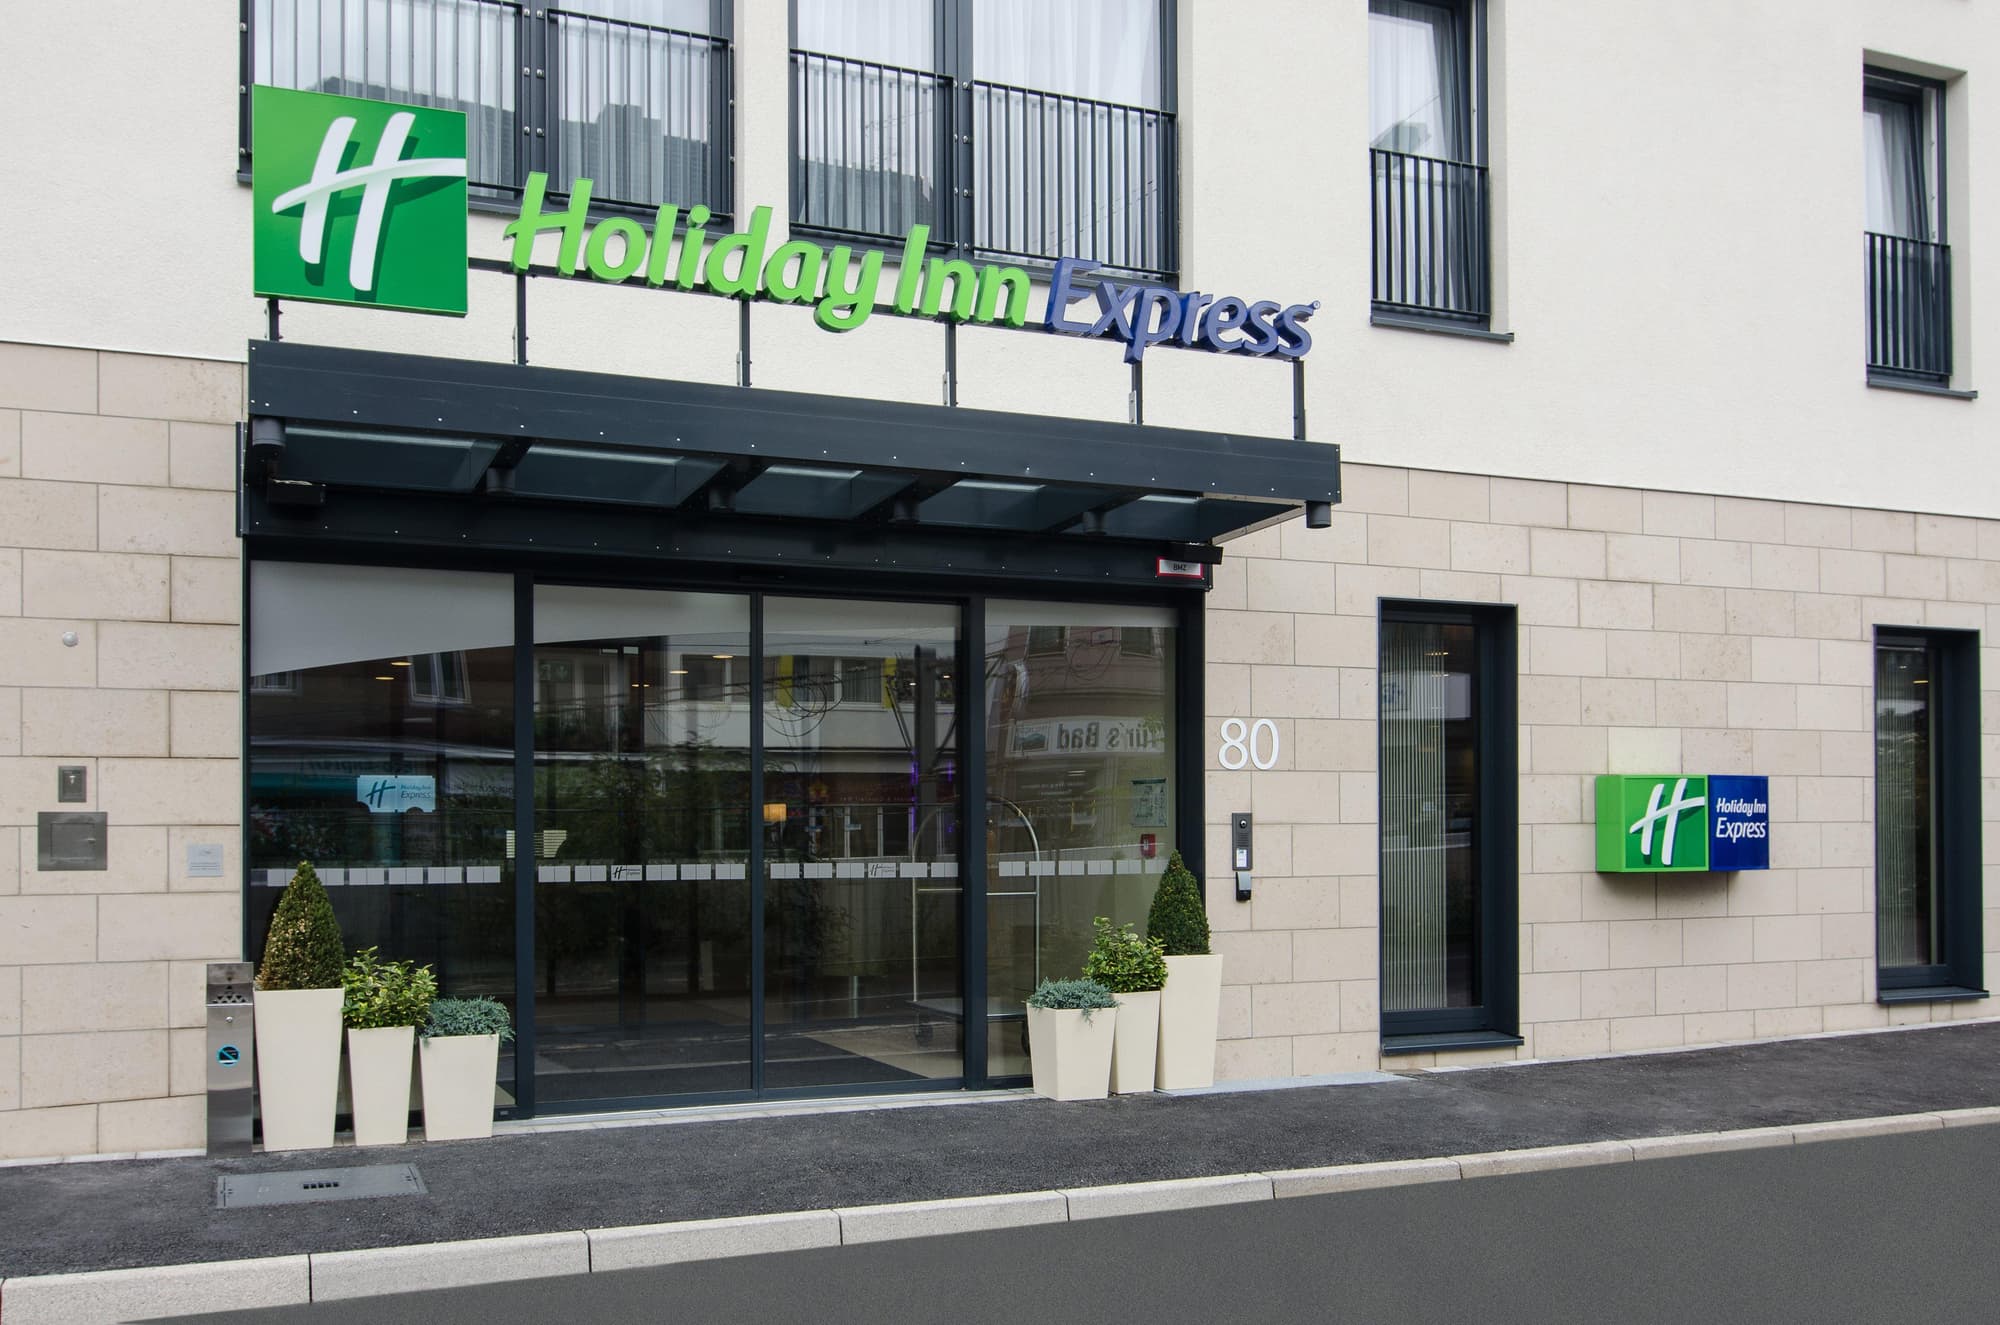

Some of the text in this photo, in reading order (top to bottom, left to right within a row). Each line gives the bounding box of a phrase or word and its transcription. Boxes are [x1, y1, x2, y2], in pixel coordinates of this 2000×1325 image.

[503, 171, 884, 333] Holiday
[893, 223, 1031, 327] Inn
[1218, 718, 1279, 770] 80
[1716, 797, 1767, 817] Holiday Inn
[1715, 817, 1766, 843] Express
